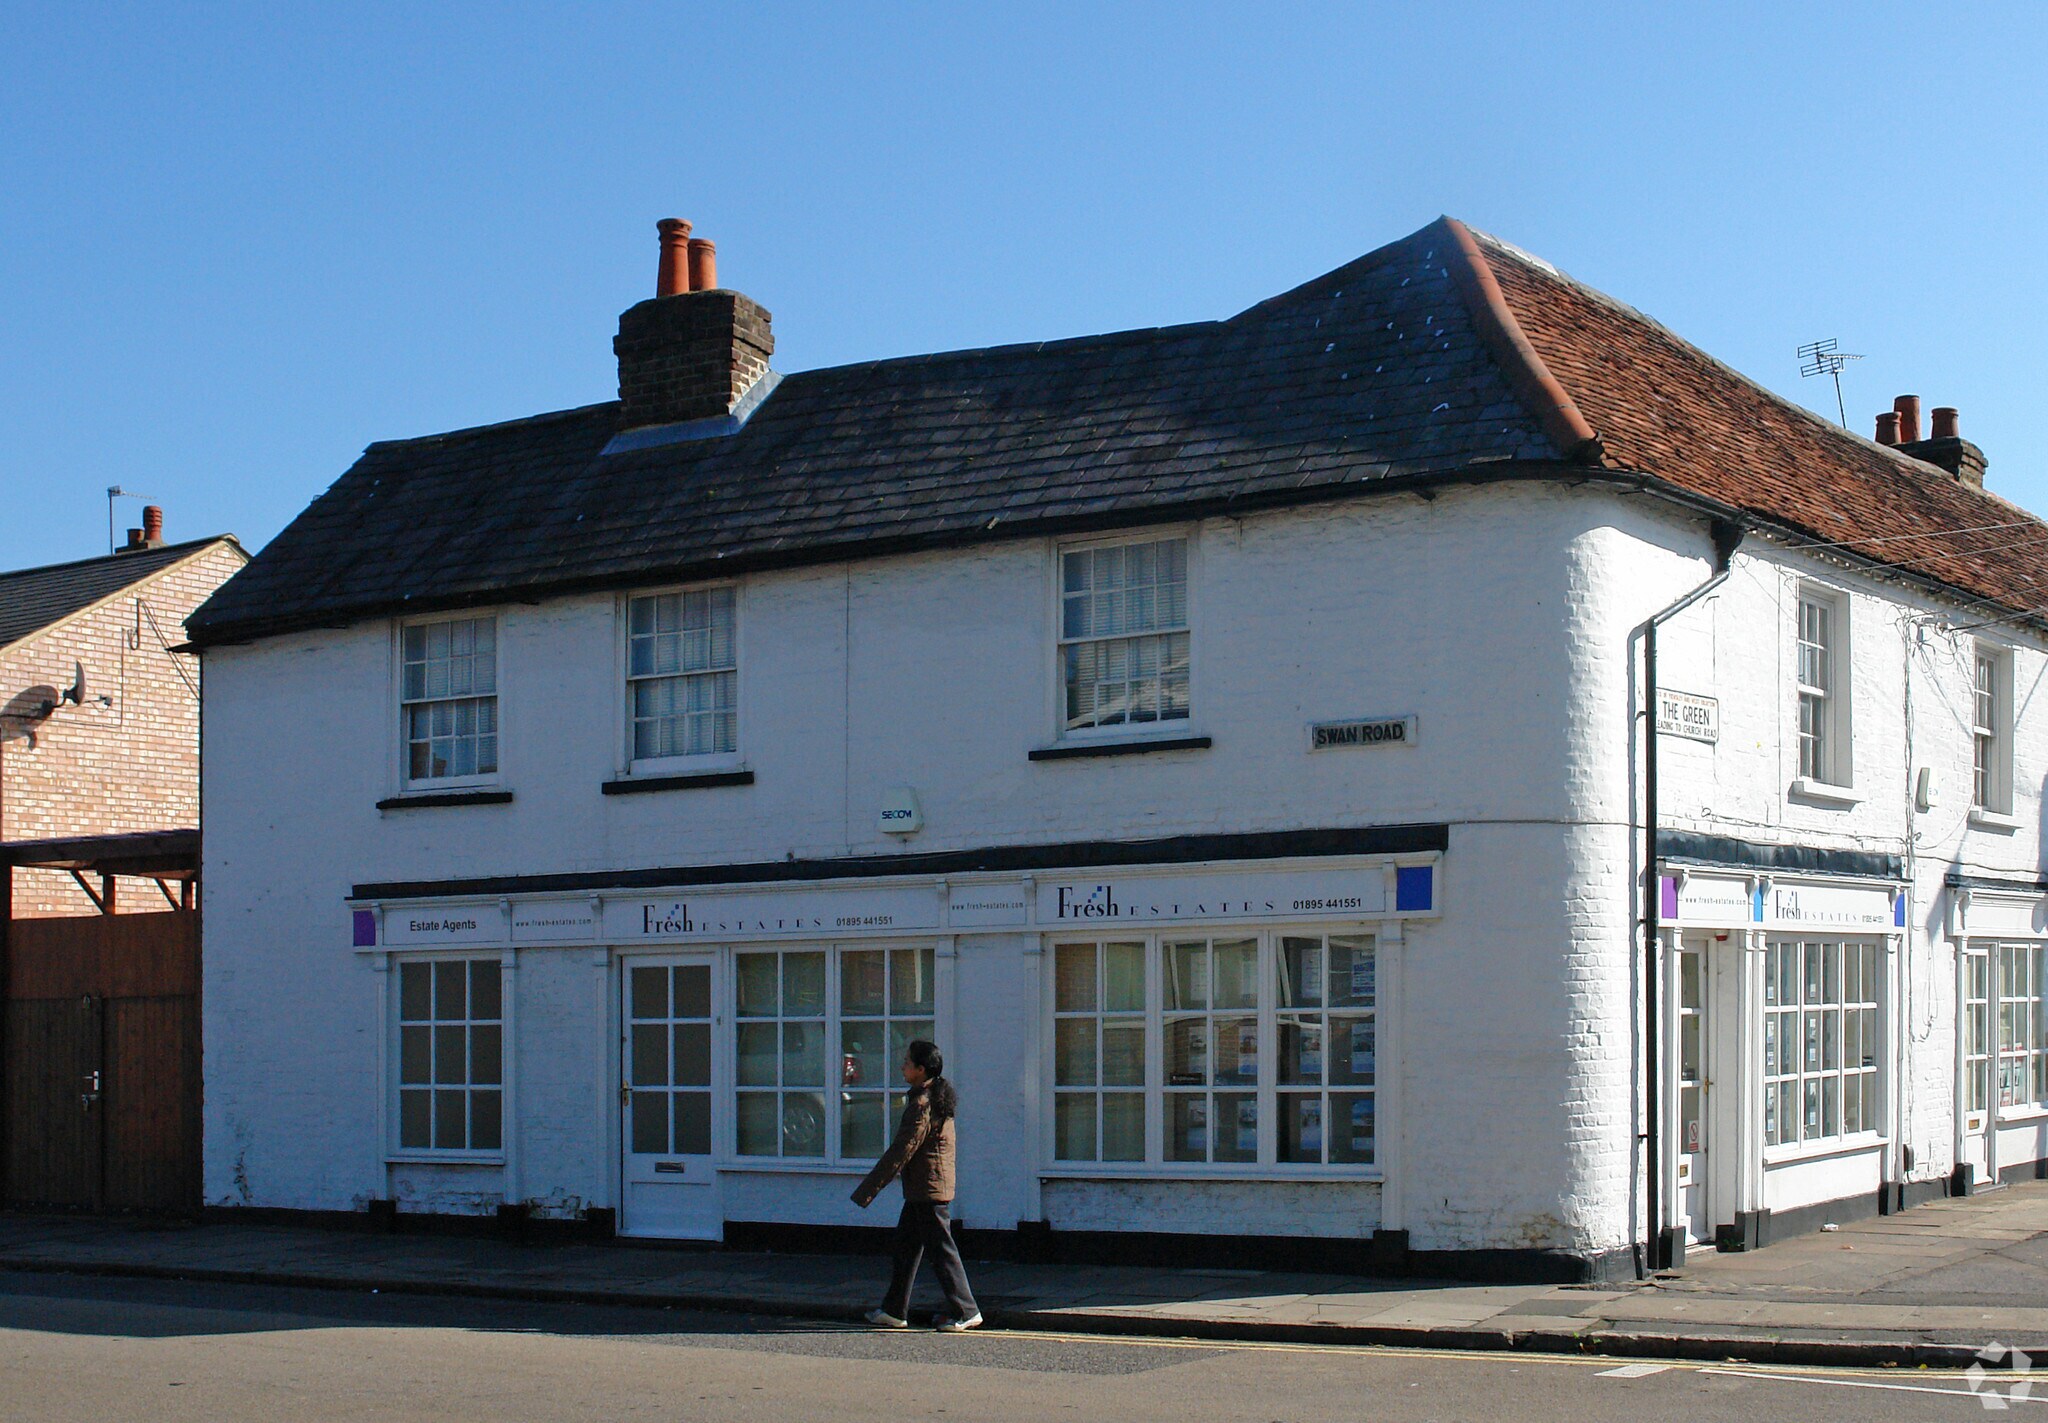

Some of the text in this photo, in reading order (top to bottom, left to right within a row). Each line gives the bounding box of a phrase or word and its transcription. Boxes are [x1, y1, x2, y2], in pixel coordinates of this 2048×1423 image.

[1663, 701, 1710, 726] THE GREEN
[1317, 724, 1404, 745] SWAN ROAD
[1675, 722, 1682, 732] TO
[1683, 725, 1702, 736] CHURCH
[1703, 728, 1717, 738] ROAD
[881, 809, 912, 820] SECOM
[951, 901, 1025, 911] www.fresh-estates.com
[1130, 900, 1275, 916] ESTATES
[1292, 897, 1363, 911] 01895 441551
[1684, 896, 1747, 906] www.fresh-estates.com
[515, 918, 593, 928] www.fresh-estates.com
[836, 915, 894, 927] 01895 441551
[1804, 911, 1858, 921] ESTATES
[409, 918, 478, 932] Estate Agents
[702, 918, 823, 932] ESTATES
